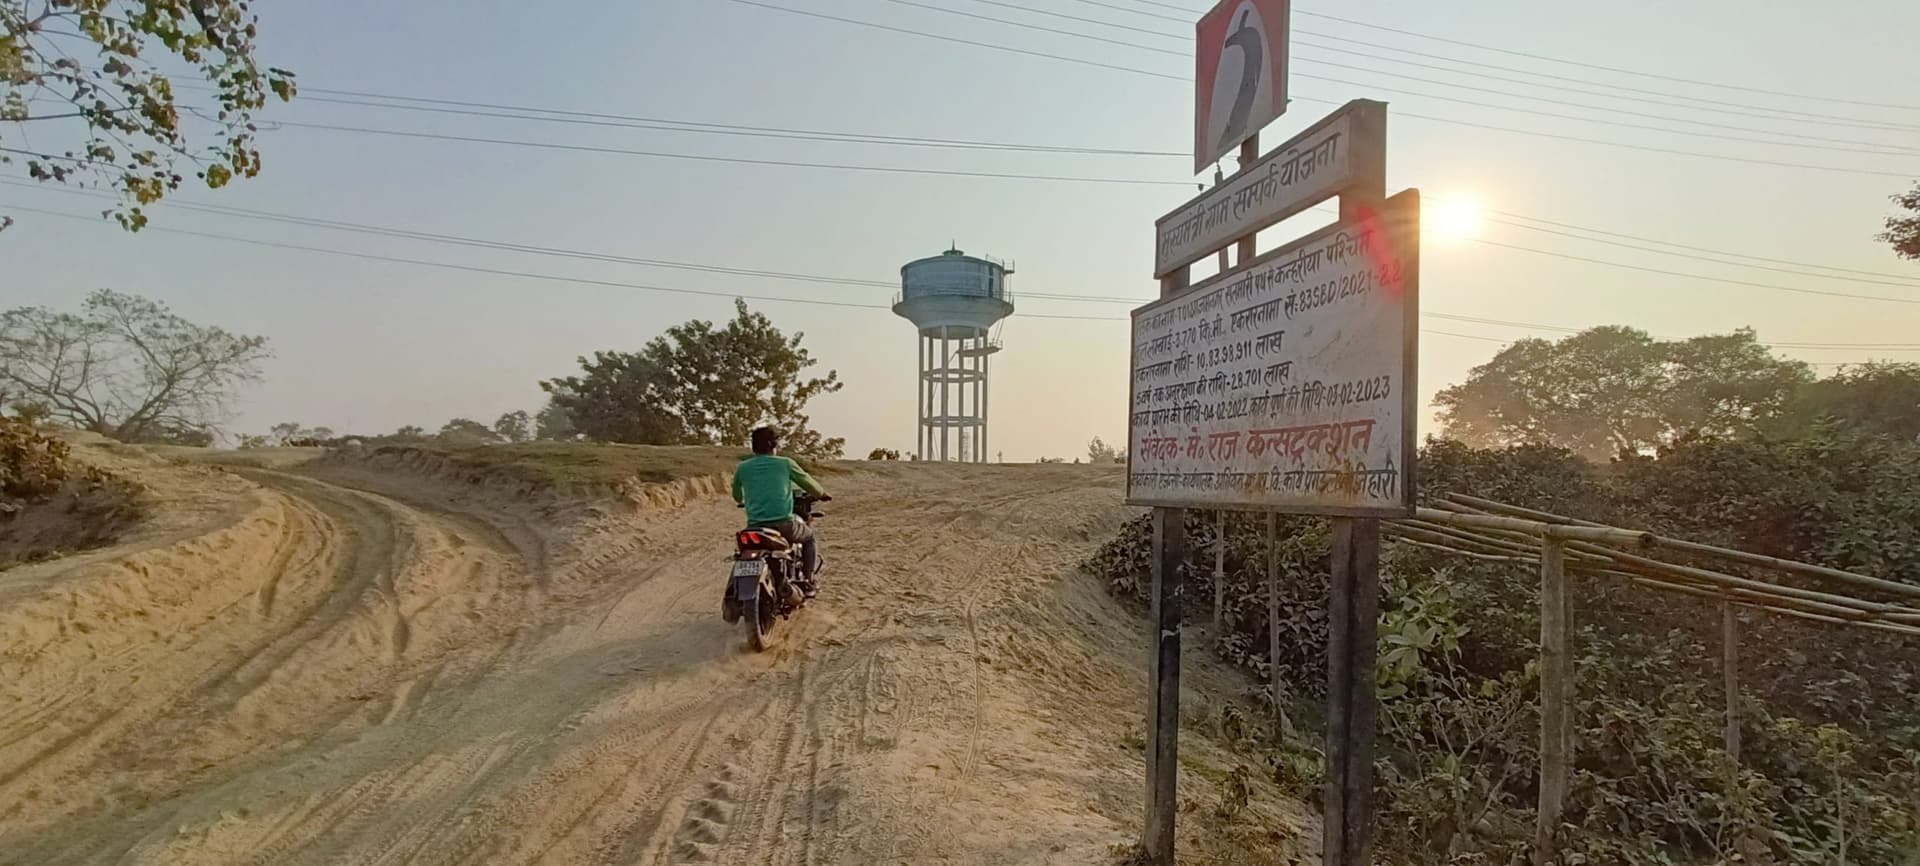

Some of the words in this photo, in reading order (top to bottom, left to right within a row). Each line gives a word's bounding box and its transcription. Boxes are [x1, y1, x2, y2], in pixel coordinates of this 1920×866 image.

[1205, 196, 1231, 232] ग्राम
[1233, 163, 1279, 220] सम्पर्क
[1280, 132, 1342, 186] योजना
[1230, 298, 1283, 333] एकरारनामा
[1255, 330, 1285, 359] लाख
[1196, 374, 1208, 398] की
[1264, 361, 1293, 386] लाख
[1250, 389, 1270, 416] कार्य
[1287, 385, 1300, 413] की
[1208, 431, 1241, 461] राज
